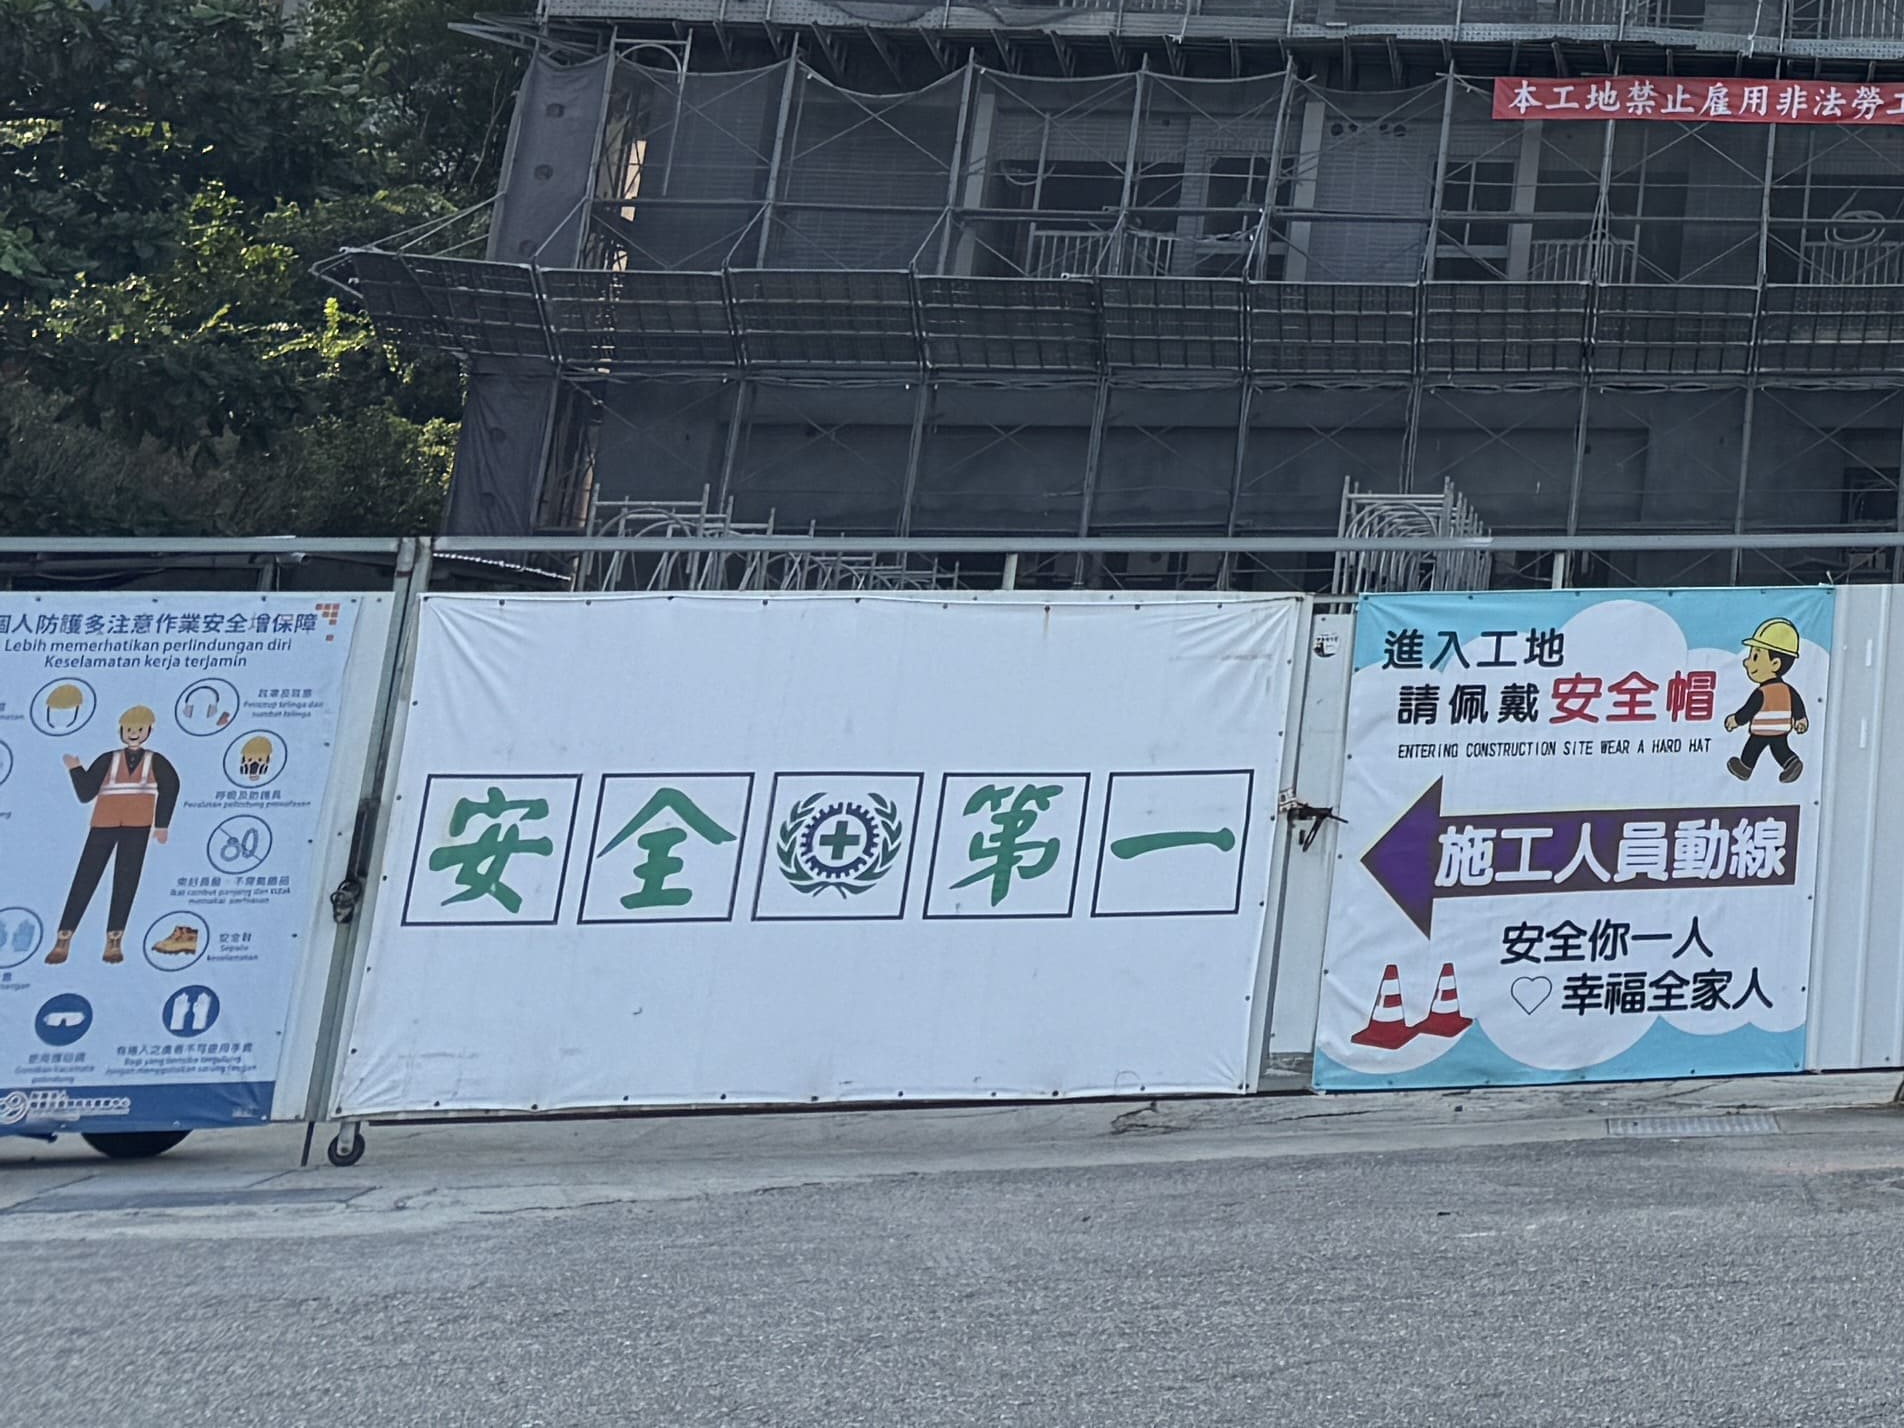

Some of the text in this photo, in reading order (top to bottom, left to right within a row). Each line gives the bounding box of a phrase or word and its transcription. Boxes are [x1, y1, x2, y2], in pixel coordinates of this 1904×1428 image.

[5, 637, 292, 655] Lebih memerhatikan perlindungan diri
[44, 653, 247, 670] Keselamatan kerja terjamin
[1382, 628, 1565, 671] 進入工地
[1396, 670, 1718, 727] 請佩戴安全帽
[1398, 738, 1713, 759] ENTERING CONSTRUCTION SITE WEAR A HARD HAT
[1434, 818, 1788, 889] 施工人員動線
[1501, 916, 1714, 965] 安全你一人
[1562, 966, 1774, 1017] 幸福全家人
